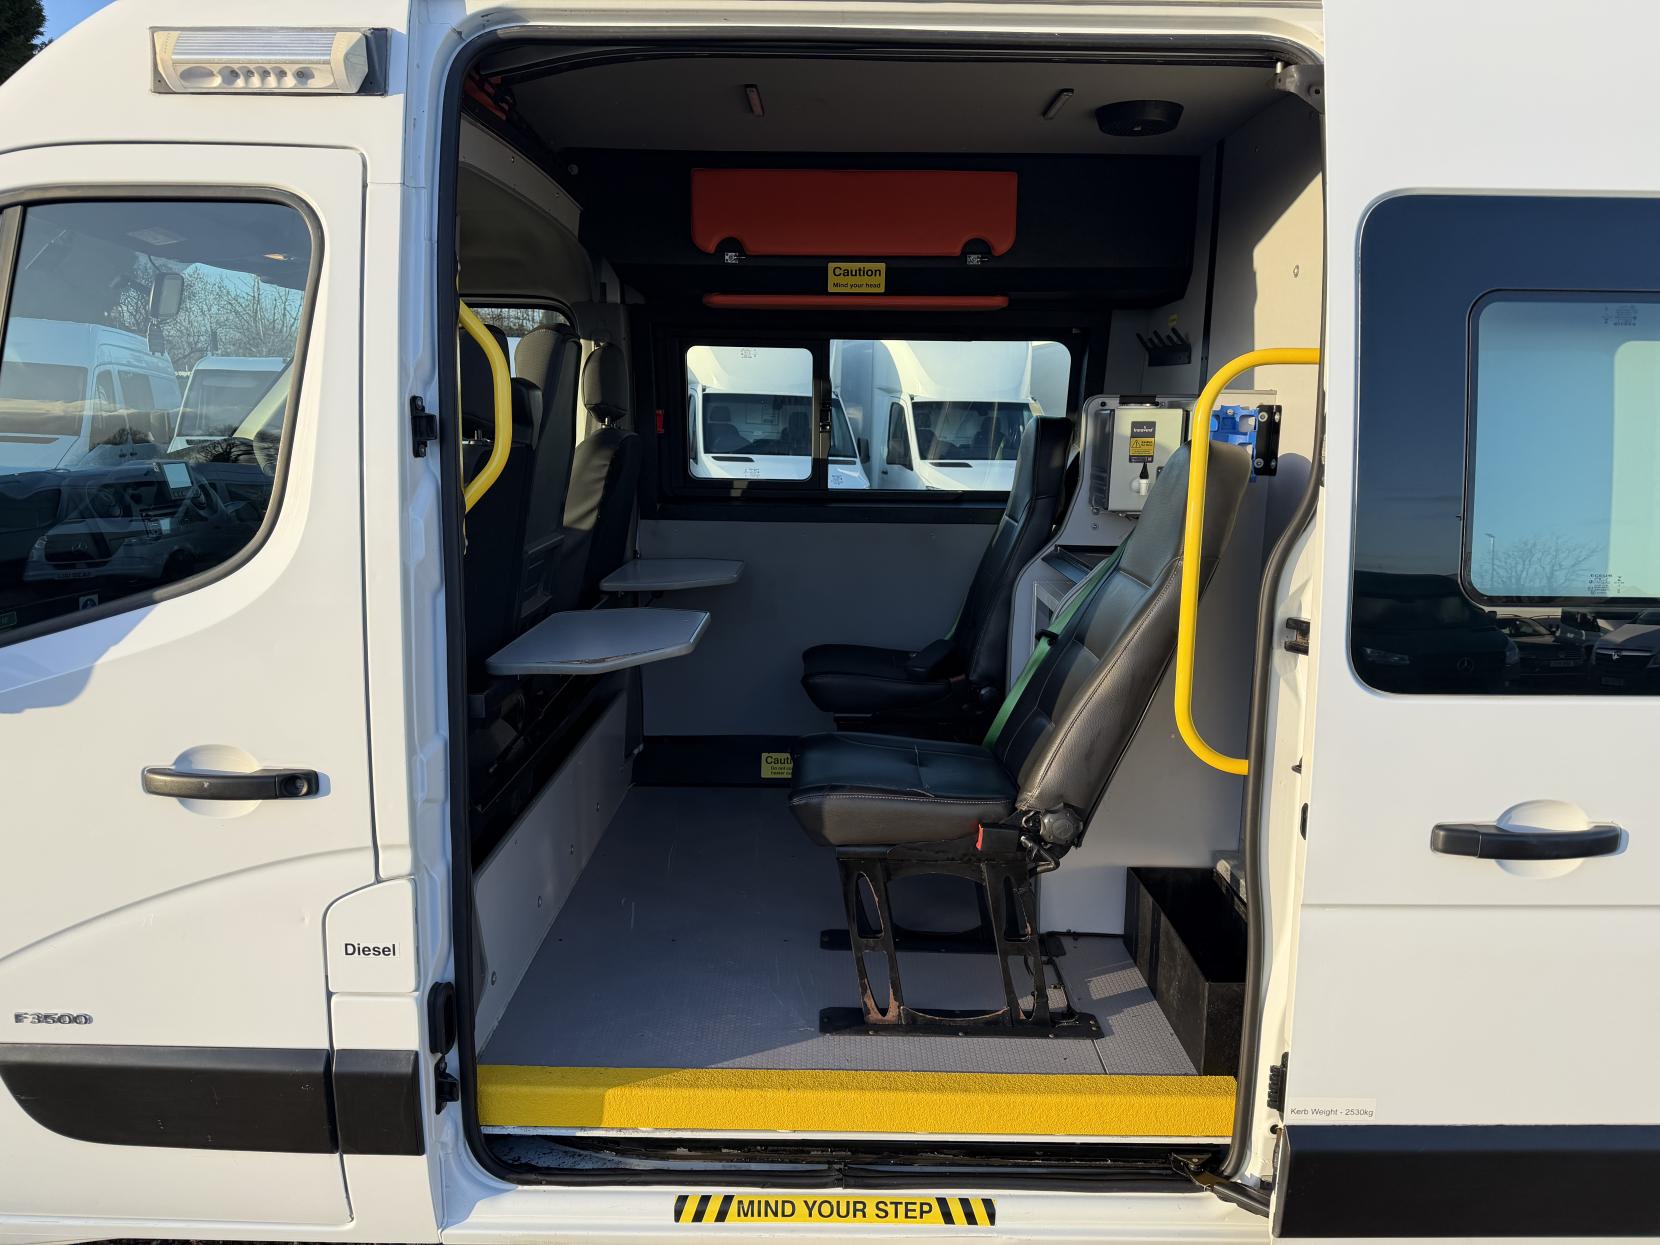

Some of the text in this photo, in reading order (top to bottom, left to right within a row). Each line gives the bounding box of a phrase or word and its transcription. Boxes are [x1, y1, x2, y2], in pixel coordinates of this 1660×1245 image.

[832, 266, 882, 277] Caution
[344, 942, 396, 956] Diesel
[14, 1012, 93, 1025] F3500
[1290, 1107, 1309, 1115] Kerb
[1311, 1108, 1338, 1117] Weight
[1345, 1108, 1374, 1118] 2530kg
[736, 1199, 933, 1220] MIND YOUR STEP
